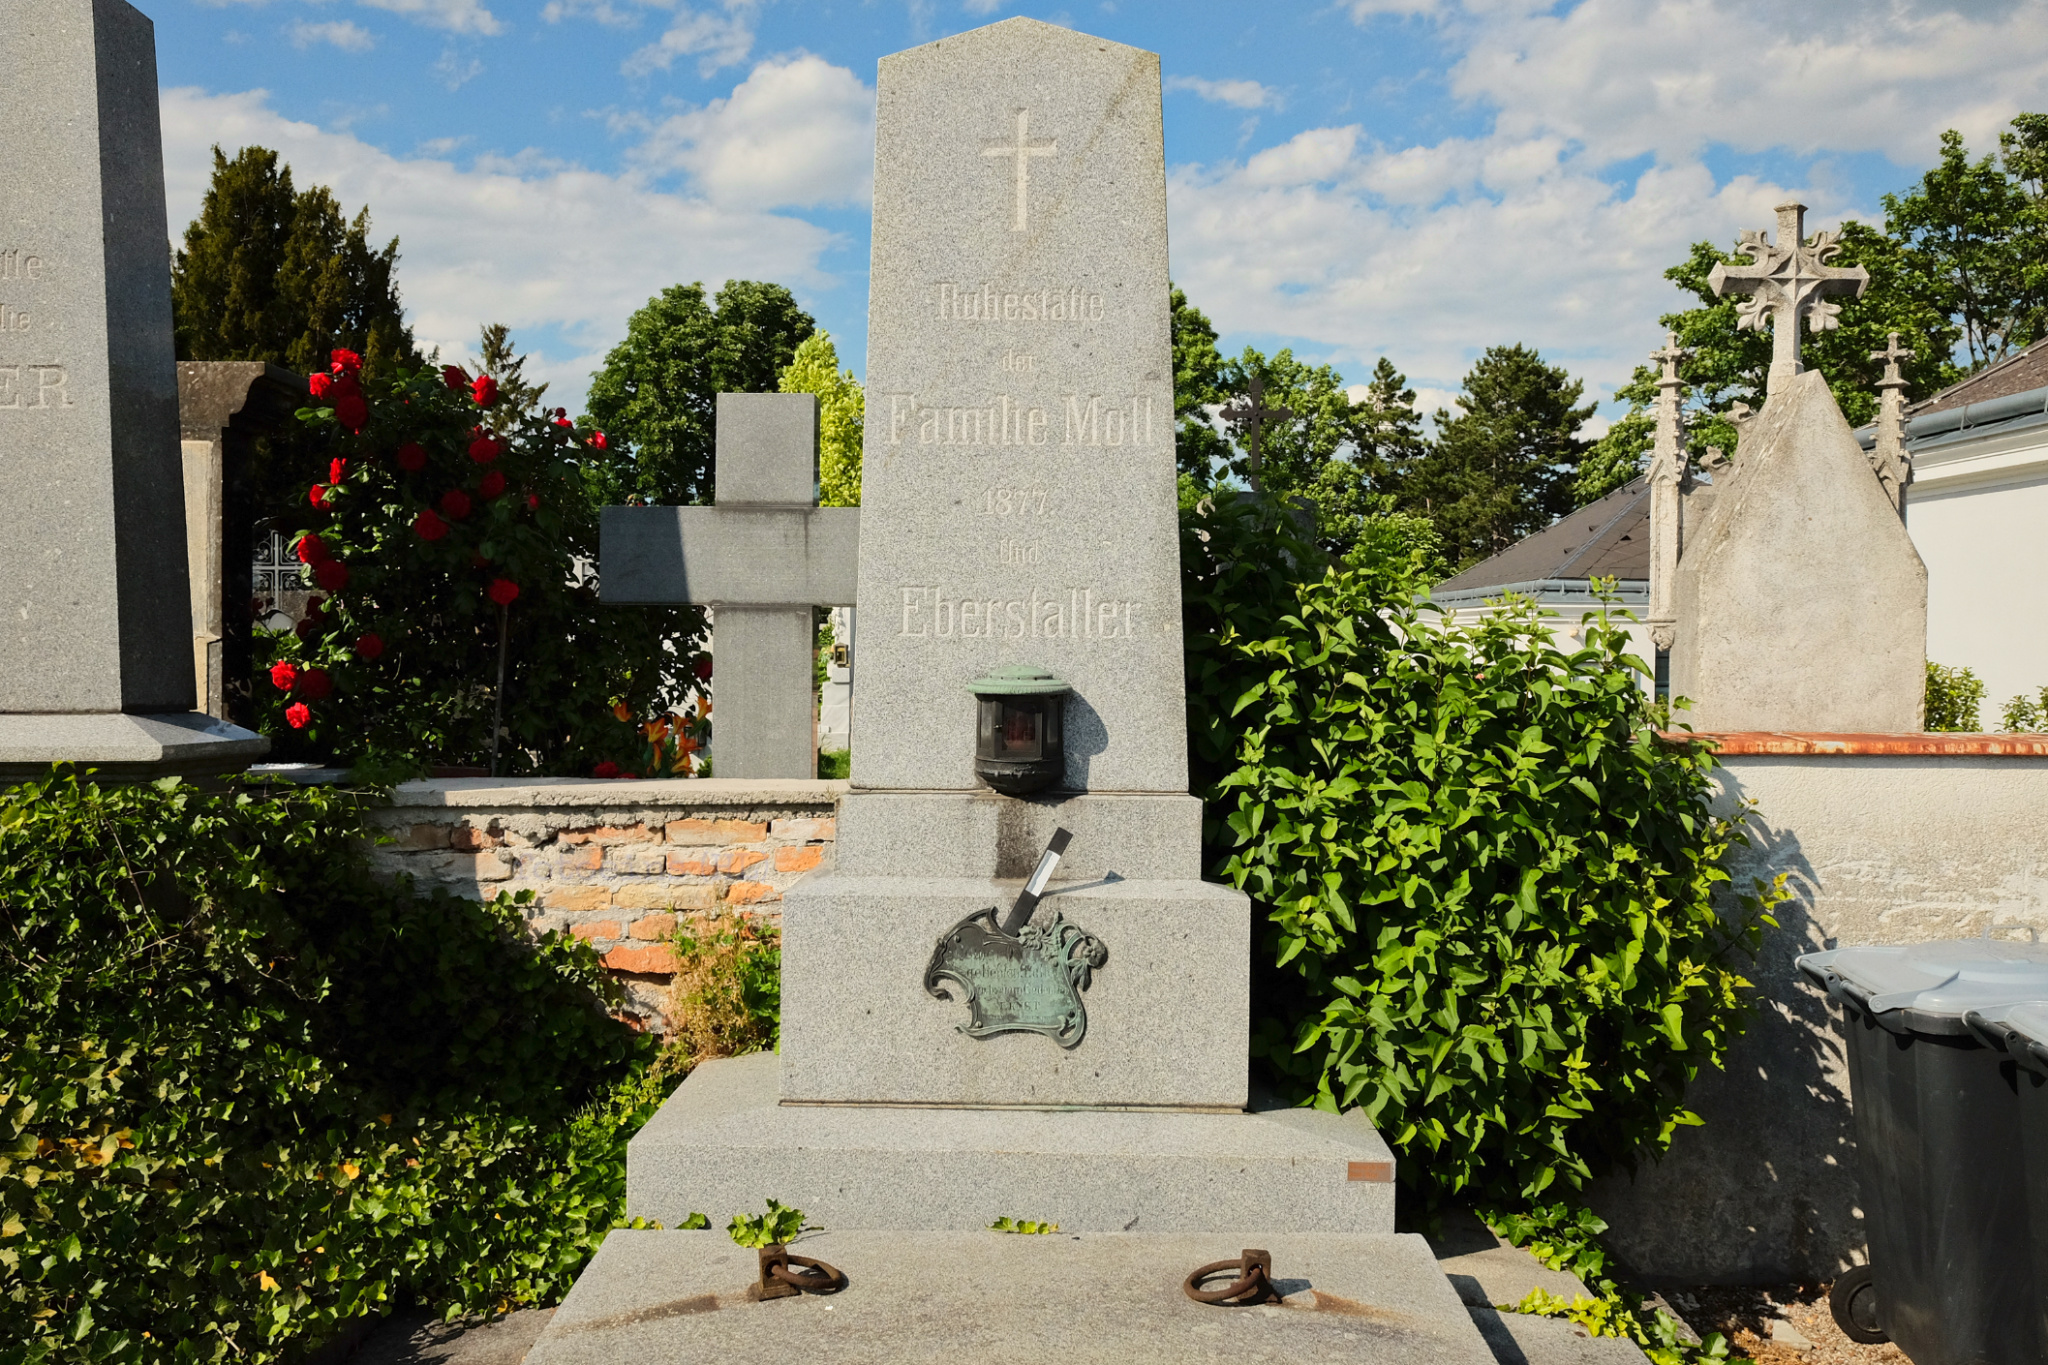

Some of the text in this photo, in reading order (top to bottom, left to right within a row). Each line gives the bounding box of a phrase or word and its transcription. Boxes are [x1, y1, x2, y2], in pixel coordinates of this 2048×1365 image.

[884, 393, 1154, 446] Familie Moll
[979, 486, 1050, 516] 1877
[898, 586, 1143, 639] Eberstaller
